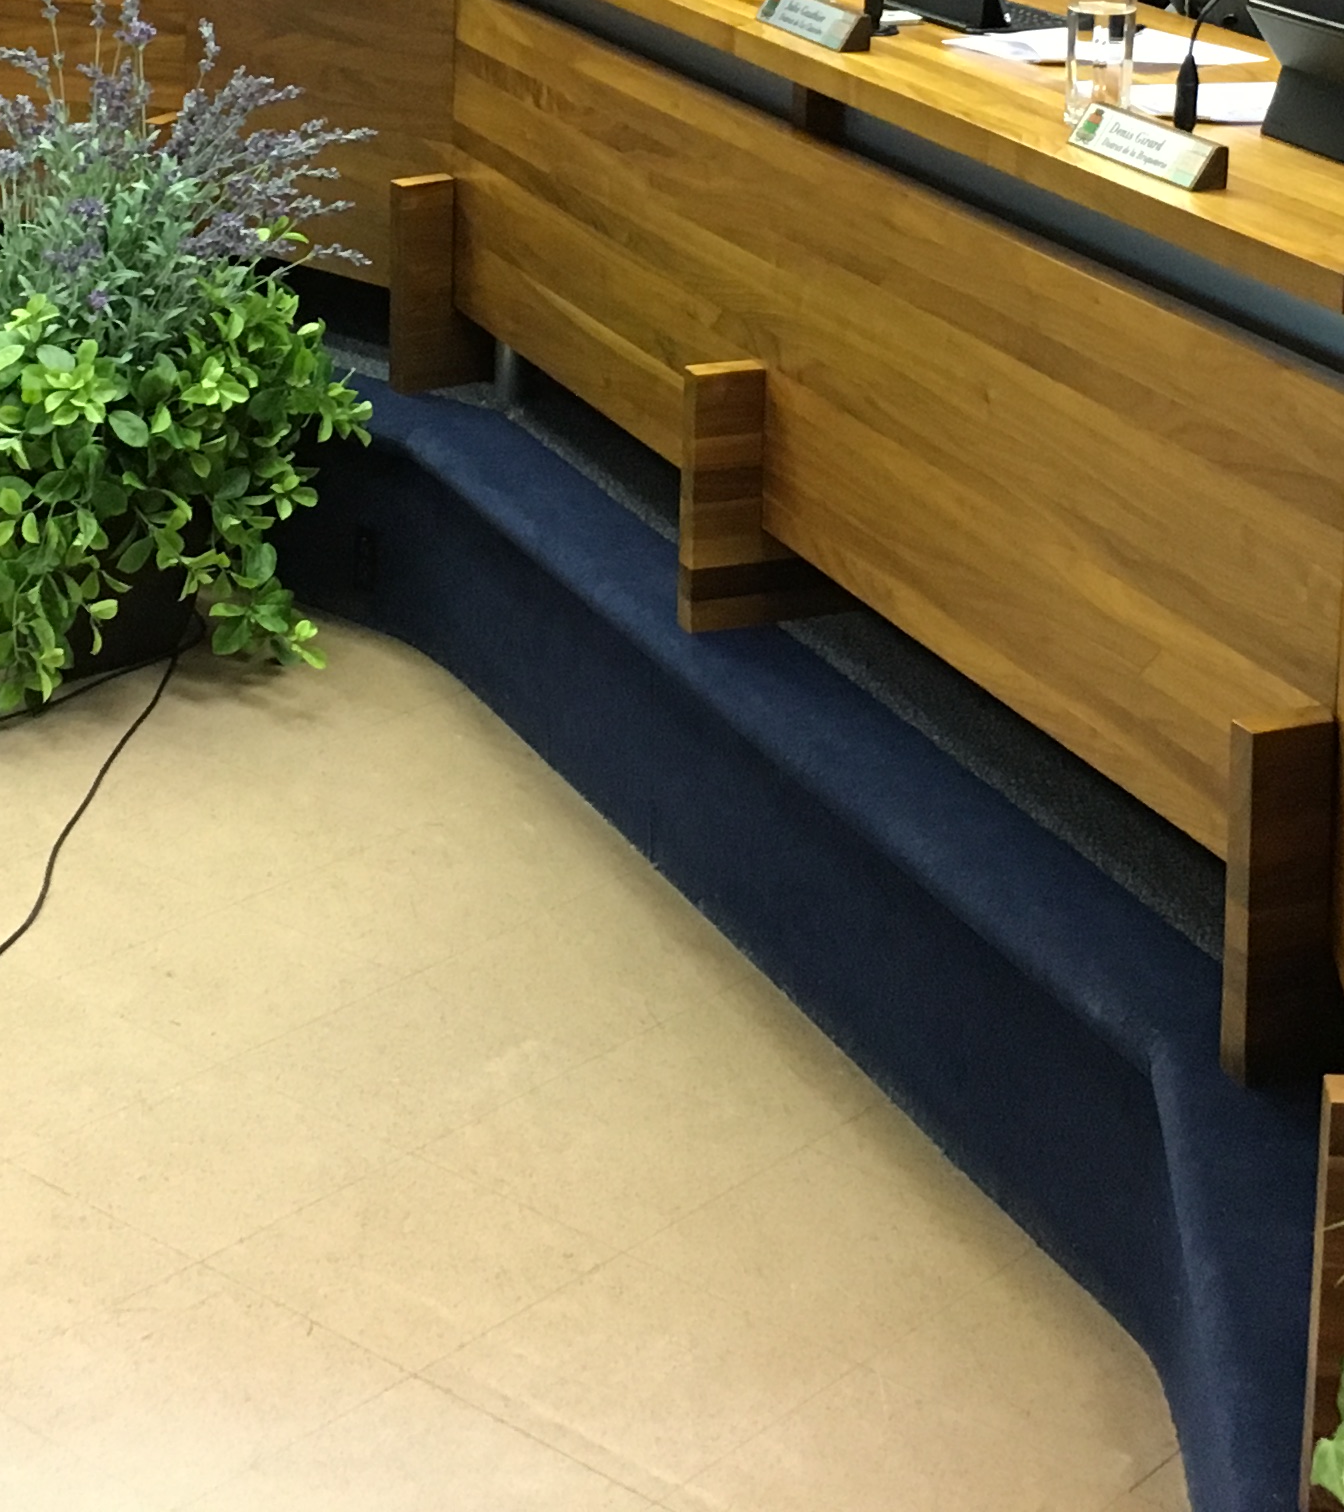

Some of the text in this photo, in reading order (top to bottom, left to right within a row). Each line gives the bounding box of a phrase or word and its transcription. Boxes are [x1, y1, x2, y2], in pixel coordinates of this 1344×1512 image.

[1109, 121, 1167, 152] Denis Girard
[1121, 145, 1130, 155] de
